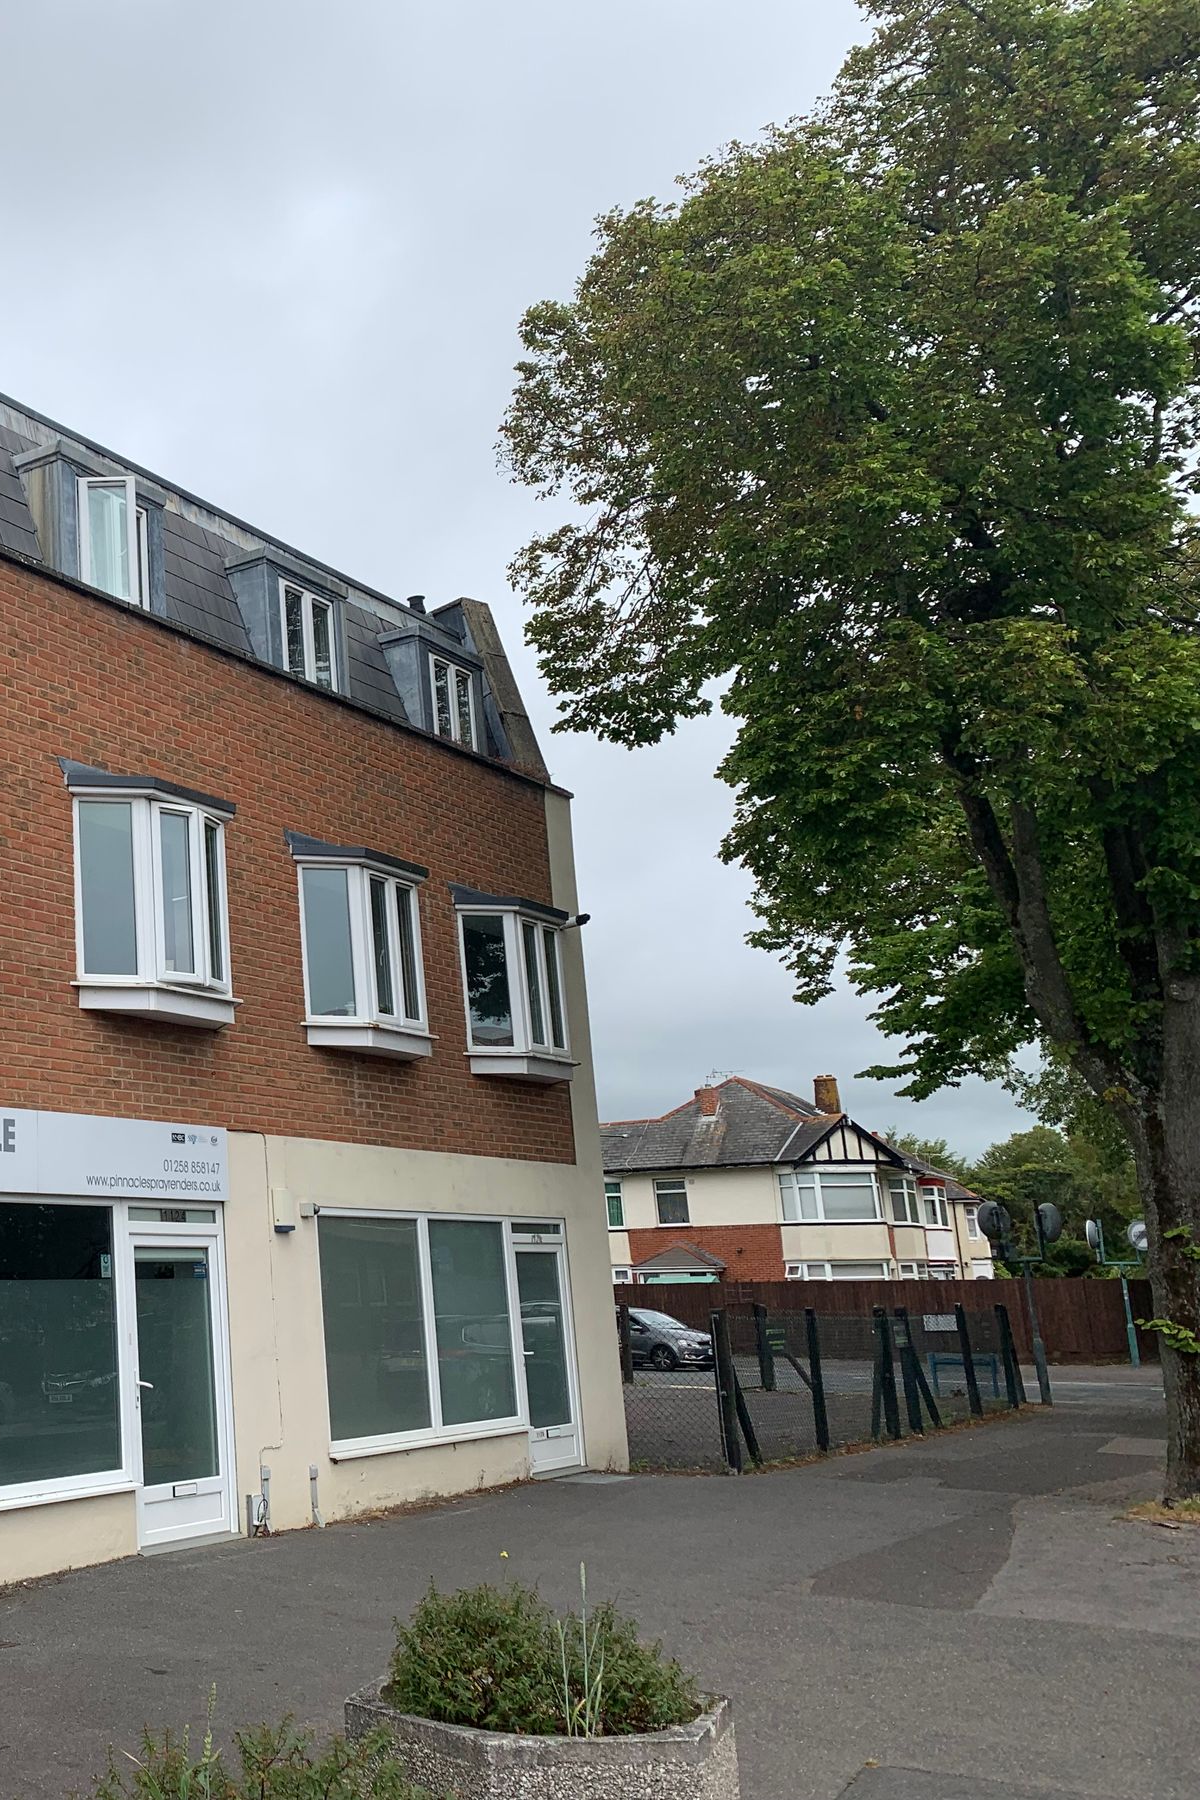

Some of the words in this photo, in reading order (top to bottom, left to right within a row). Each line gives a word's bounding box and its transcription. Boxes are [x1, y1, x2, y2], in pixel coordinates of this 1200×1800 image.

[163, 1159, 189, 1174] 01258
[190, 1160, 220, 1175] 858147
[86, 1174, 221, 1193] www.pinnaclesprayrenders.co.uk
